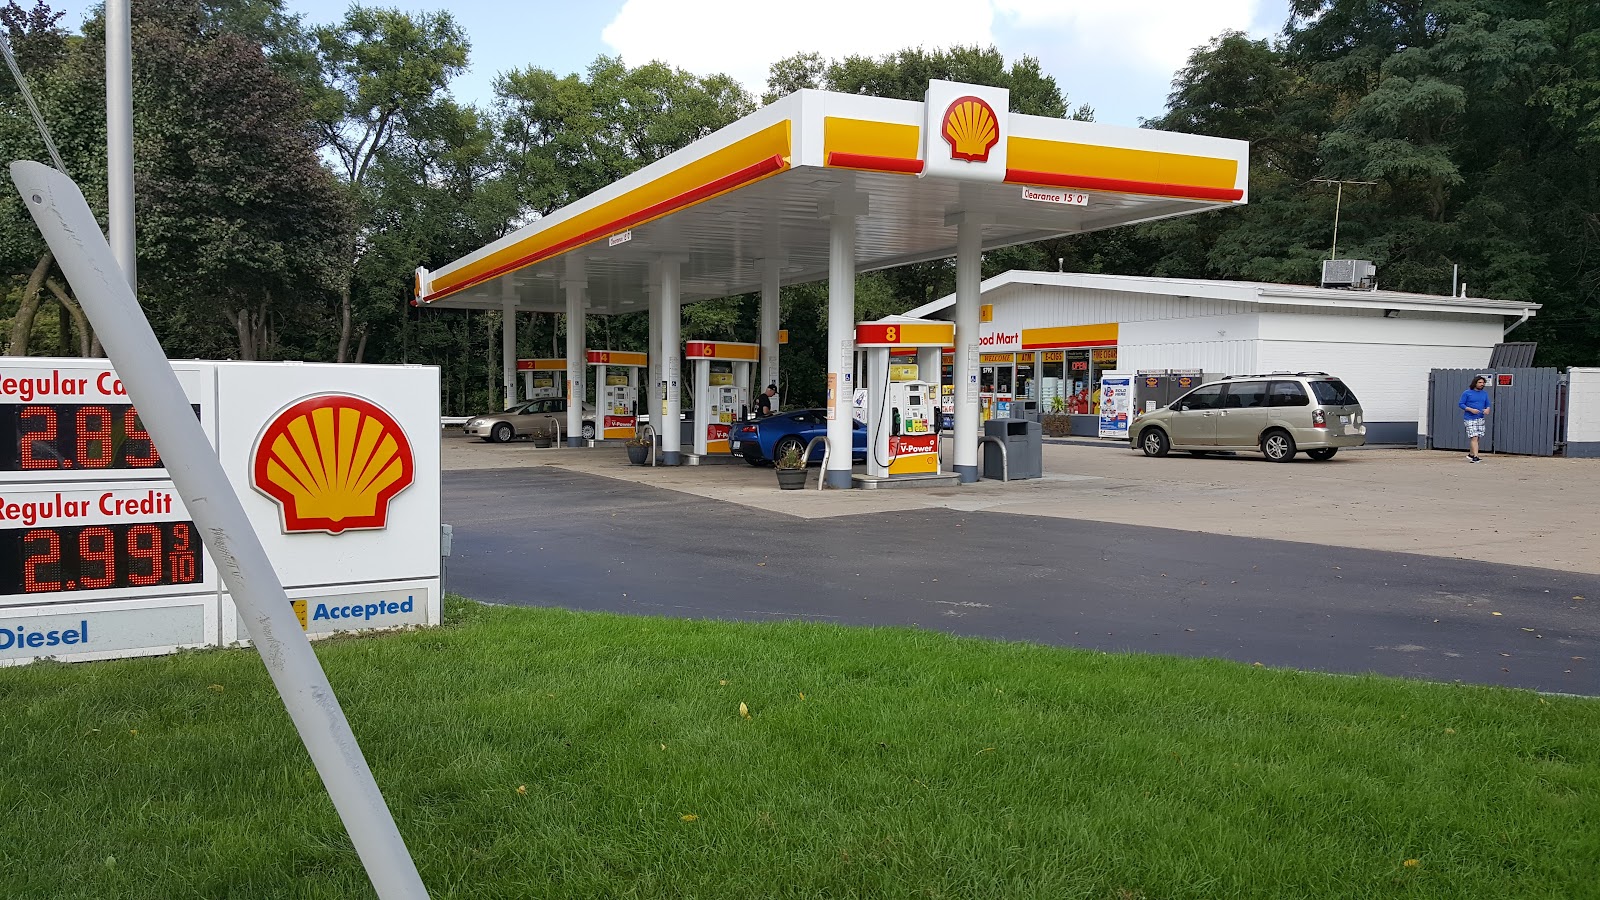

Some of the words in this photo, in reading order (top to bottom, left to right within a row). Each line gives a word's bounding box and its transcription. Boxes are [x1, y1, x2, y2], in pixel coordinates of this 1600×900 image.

[1024, 189, 1060, 202] Clearance
[885, 326, 897, 342] 8
[979, 331, 994, 346] ood
[996, 332, 1019, 345] Mart
[703, 345, 713, 356] 6
[1021, 353, 1032, 361] ATM
[600, 353, 608, 362] 4
[984, 354, 1011, 362] WELCOME
[527, 361, 534, 369] 2
[1071, 361, 1088, 371] OPEN
[0, 370, 88, 402] egular
[900, 445, 933, 453] V-Power
[99, 490, 172, 516] Credit
[24, 524, 163, 592] 2.99
[312, 595, 413, 621] Accepted
[0, 620, 88, 650] Diesel
